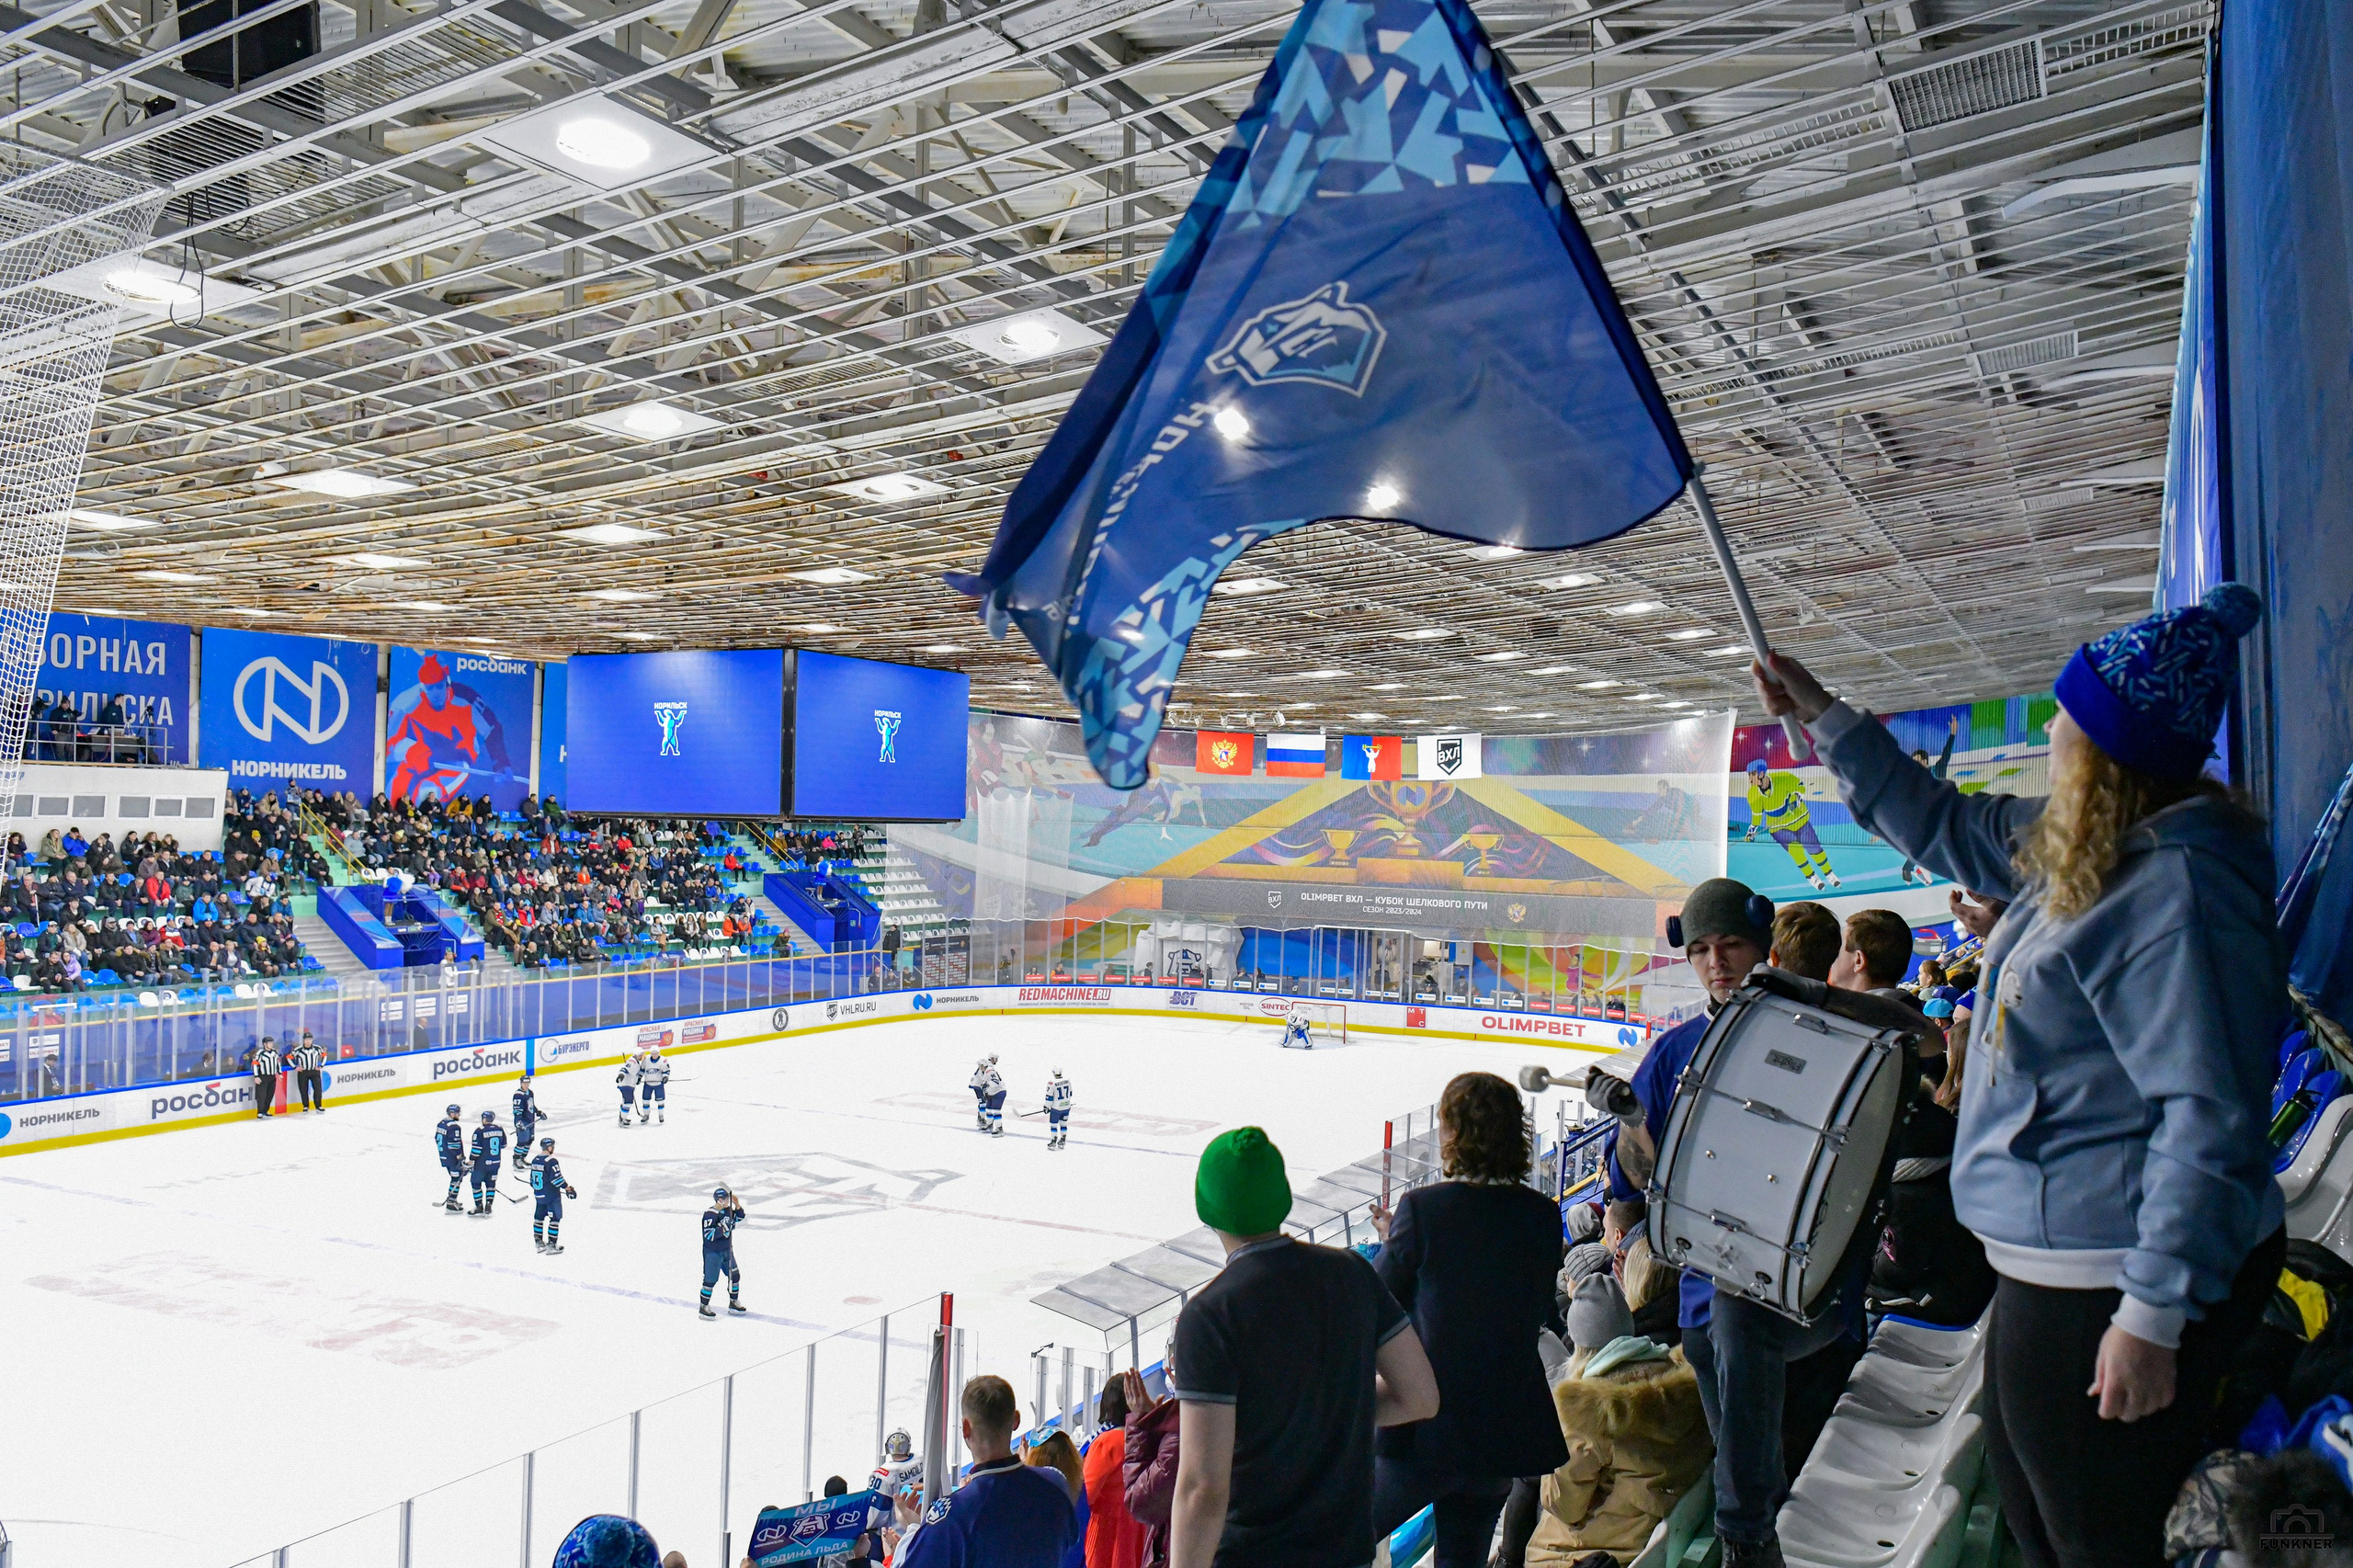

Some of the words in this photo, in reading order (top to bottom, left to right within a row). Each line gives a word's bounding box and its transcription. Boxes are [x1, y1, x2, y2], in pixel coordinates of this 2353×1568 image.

[457, 656, 528, 675] росбанк
[654, 701, 688, 710] НОРИЛЬСК
[874, 710, 902, 719] НОРИЛЬСК
[1438, 745, 1461, 764] ВХЛ
[232, 759, 347, 779] НОРНИКЕЛЬ
[1301, 892, 1344, 903] OLIMPBET
[1345, 894, 1363, 903] ВХЛ
[1375, 896, 1404, 906] КУБОК
[1405, 897, 1462, 908] ШЕЛКОВОГО
[1464, 901, 1488, 910] ПУТИ
[1362, 905, 1384, 914] СЕЗОН
[1385, 906, 1422, 915] 2023/2024
[936, 995, 980, 1004] НОРНИКЕЛЬ
[1018, 988, 1111, 1001] REDMACHINE.RU
[840, 1002, 877, 1015] VHLRU.RU
[1261, 1003, 1290, 1011] SINTEC
[1482, 1016, 1586, 1038] OLIMPBET
[558, 1040, 590, 1055] БУРЭНЕРГО
[433, 1048, 521, 1080] росбанк
[337, 1068, 396, 1084] НОРНИКЕЛЬ
[152, 1082, 256, 1119] росбан
[1056, 1085, 1070, 1100] 17
[19, 1108, 100, 1128] НОРНИКЕЛЬ
[489, 1137, 500, 1155] 9
[869, 1474, 882, 1490] 30
[794, 1498, 838, 1517] МЫ
[761, 1549, 813, 1565] РОДИНА
[814, 1541, 848, 1555] ЛЬДА
